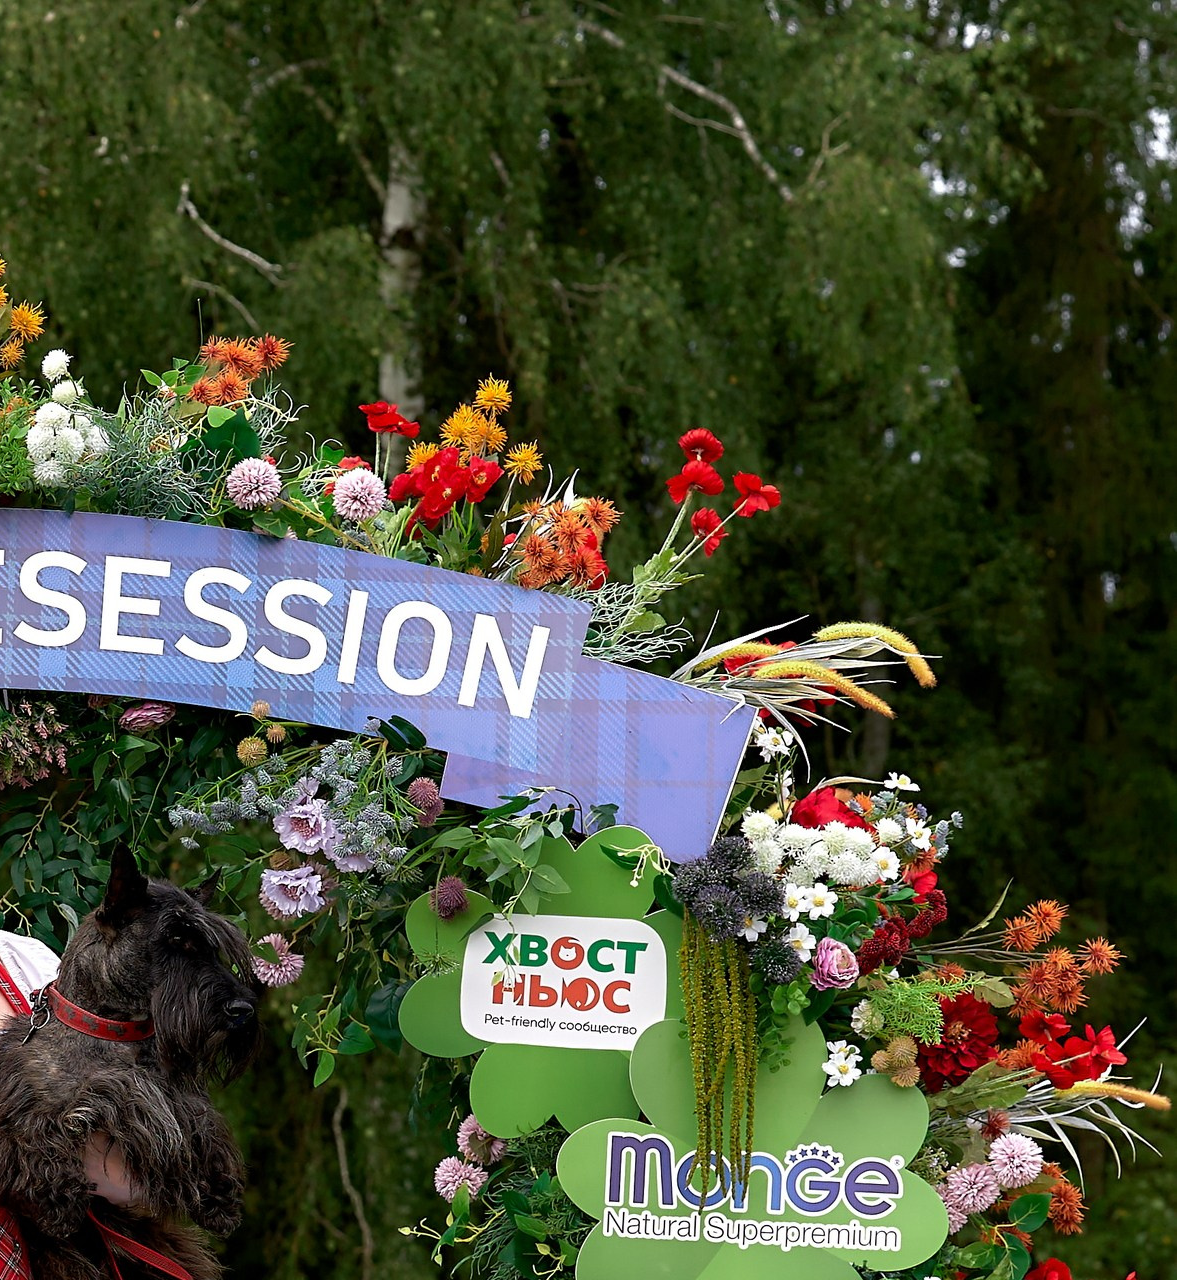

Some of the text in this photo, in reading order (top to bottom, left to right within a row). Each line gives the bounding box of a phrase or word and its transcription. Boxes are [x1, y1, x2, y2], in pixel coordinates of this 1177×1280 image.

[482, 931, 649, 975] ХВОСТ
[484, 1013, 638, 1036] Pet-friendly сообщество
[605, 1210, 898, 1248] Natural Superpremium
